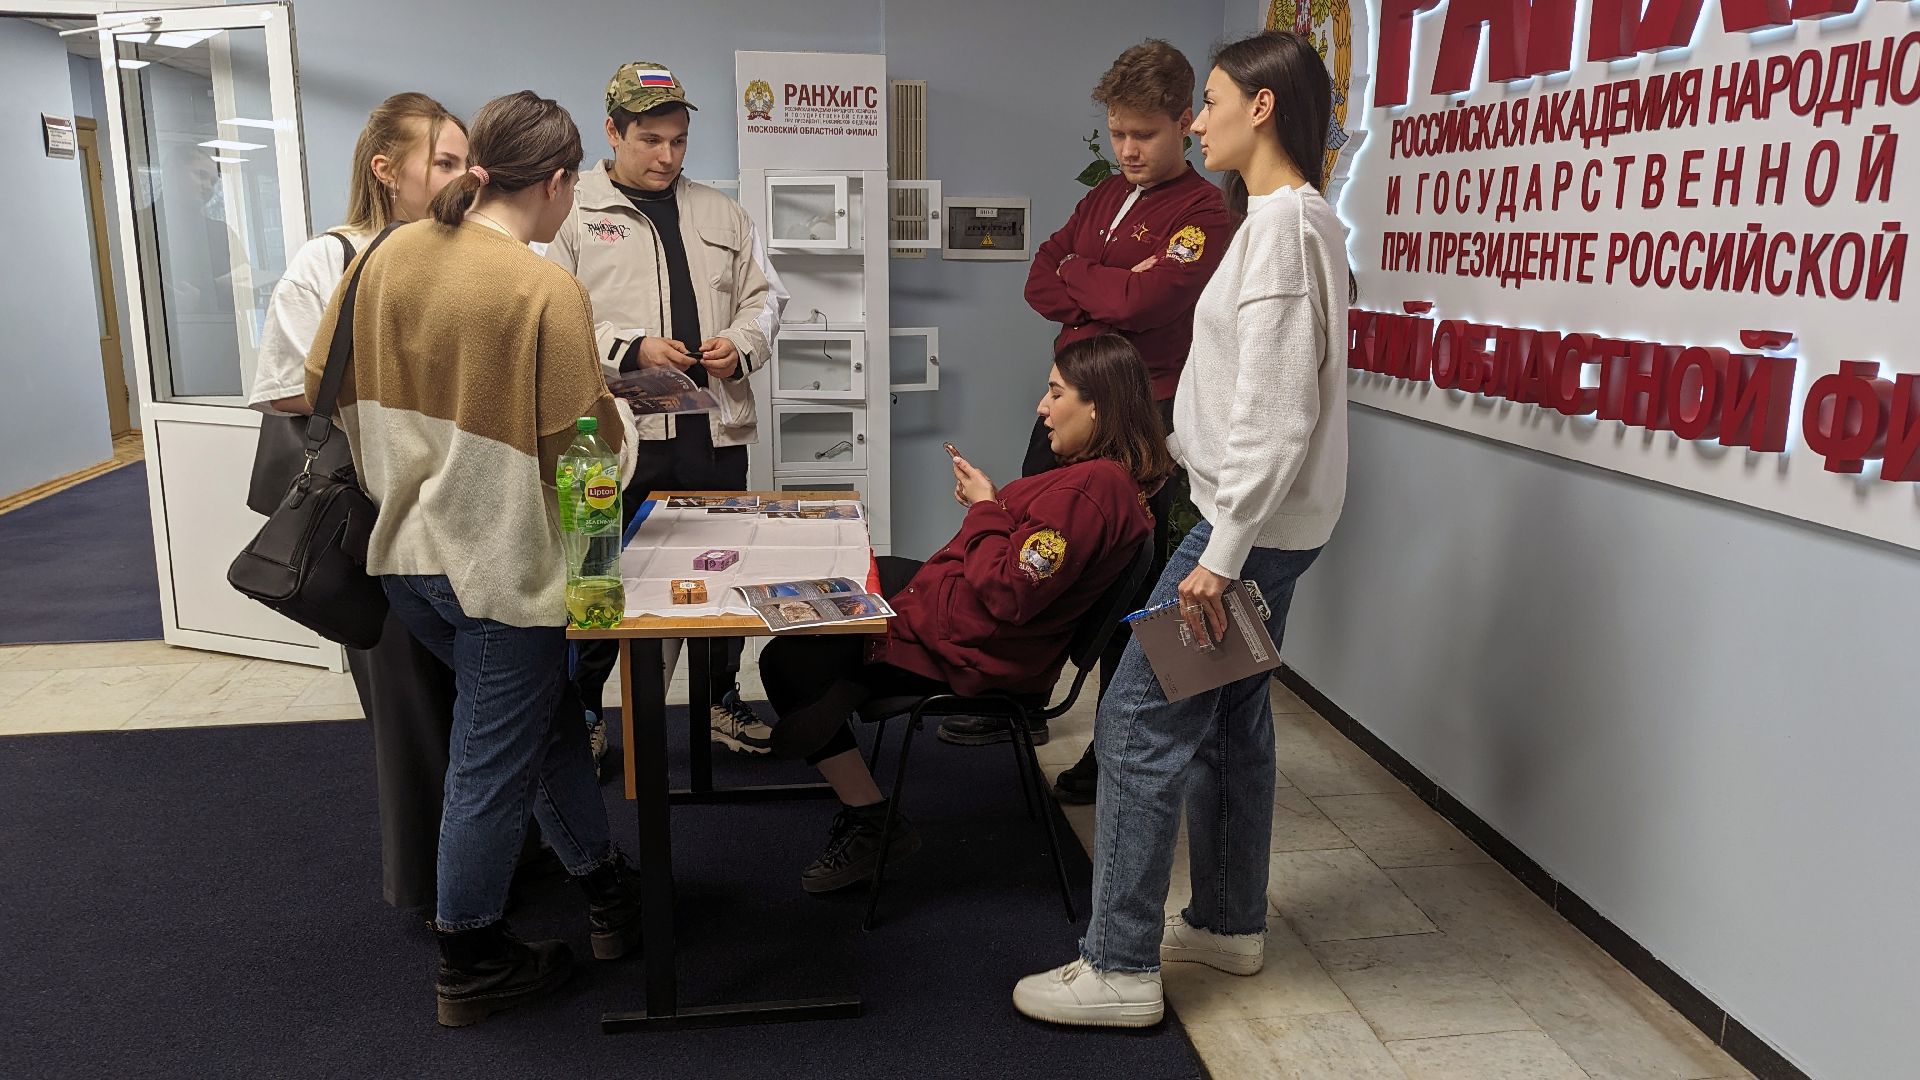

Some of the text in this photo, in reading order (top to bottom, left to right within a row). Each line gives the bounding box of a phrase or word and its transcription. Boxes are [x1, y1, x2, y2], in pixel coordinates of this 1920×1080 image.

[747, 124, 878, 137] МОСКОВСКИЙ ОБЛАСТНОЙ ФИЛИАЛ
[784, 84, 878, 108] РАНХиГС
[1391, 99, 1529, 158] РОССИЙСКАЯ
[1529, 69, 1703, 149] АКАДЕМИЯ
[1387, 123, 1898, 221] И ГОСУДАРСТВЕННОЙ
[1381, 222, 1908, 302] ПРИ ПРЕЗИДЕНТЕ РОССИЙСКОЙ
[1431, 320, 1798, 453] ОБЛАСТНОЙ
[589, 488, 614, 497] Lipton
